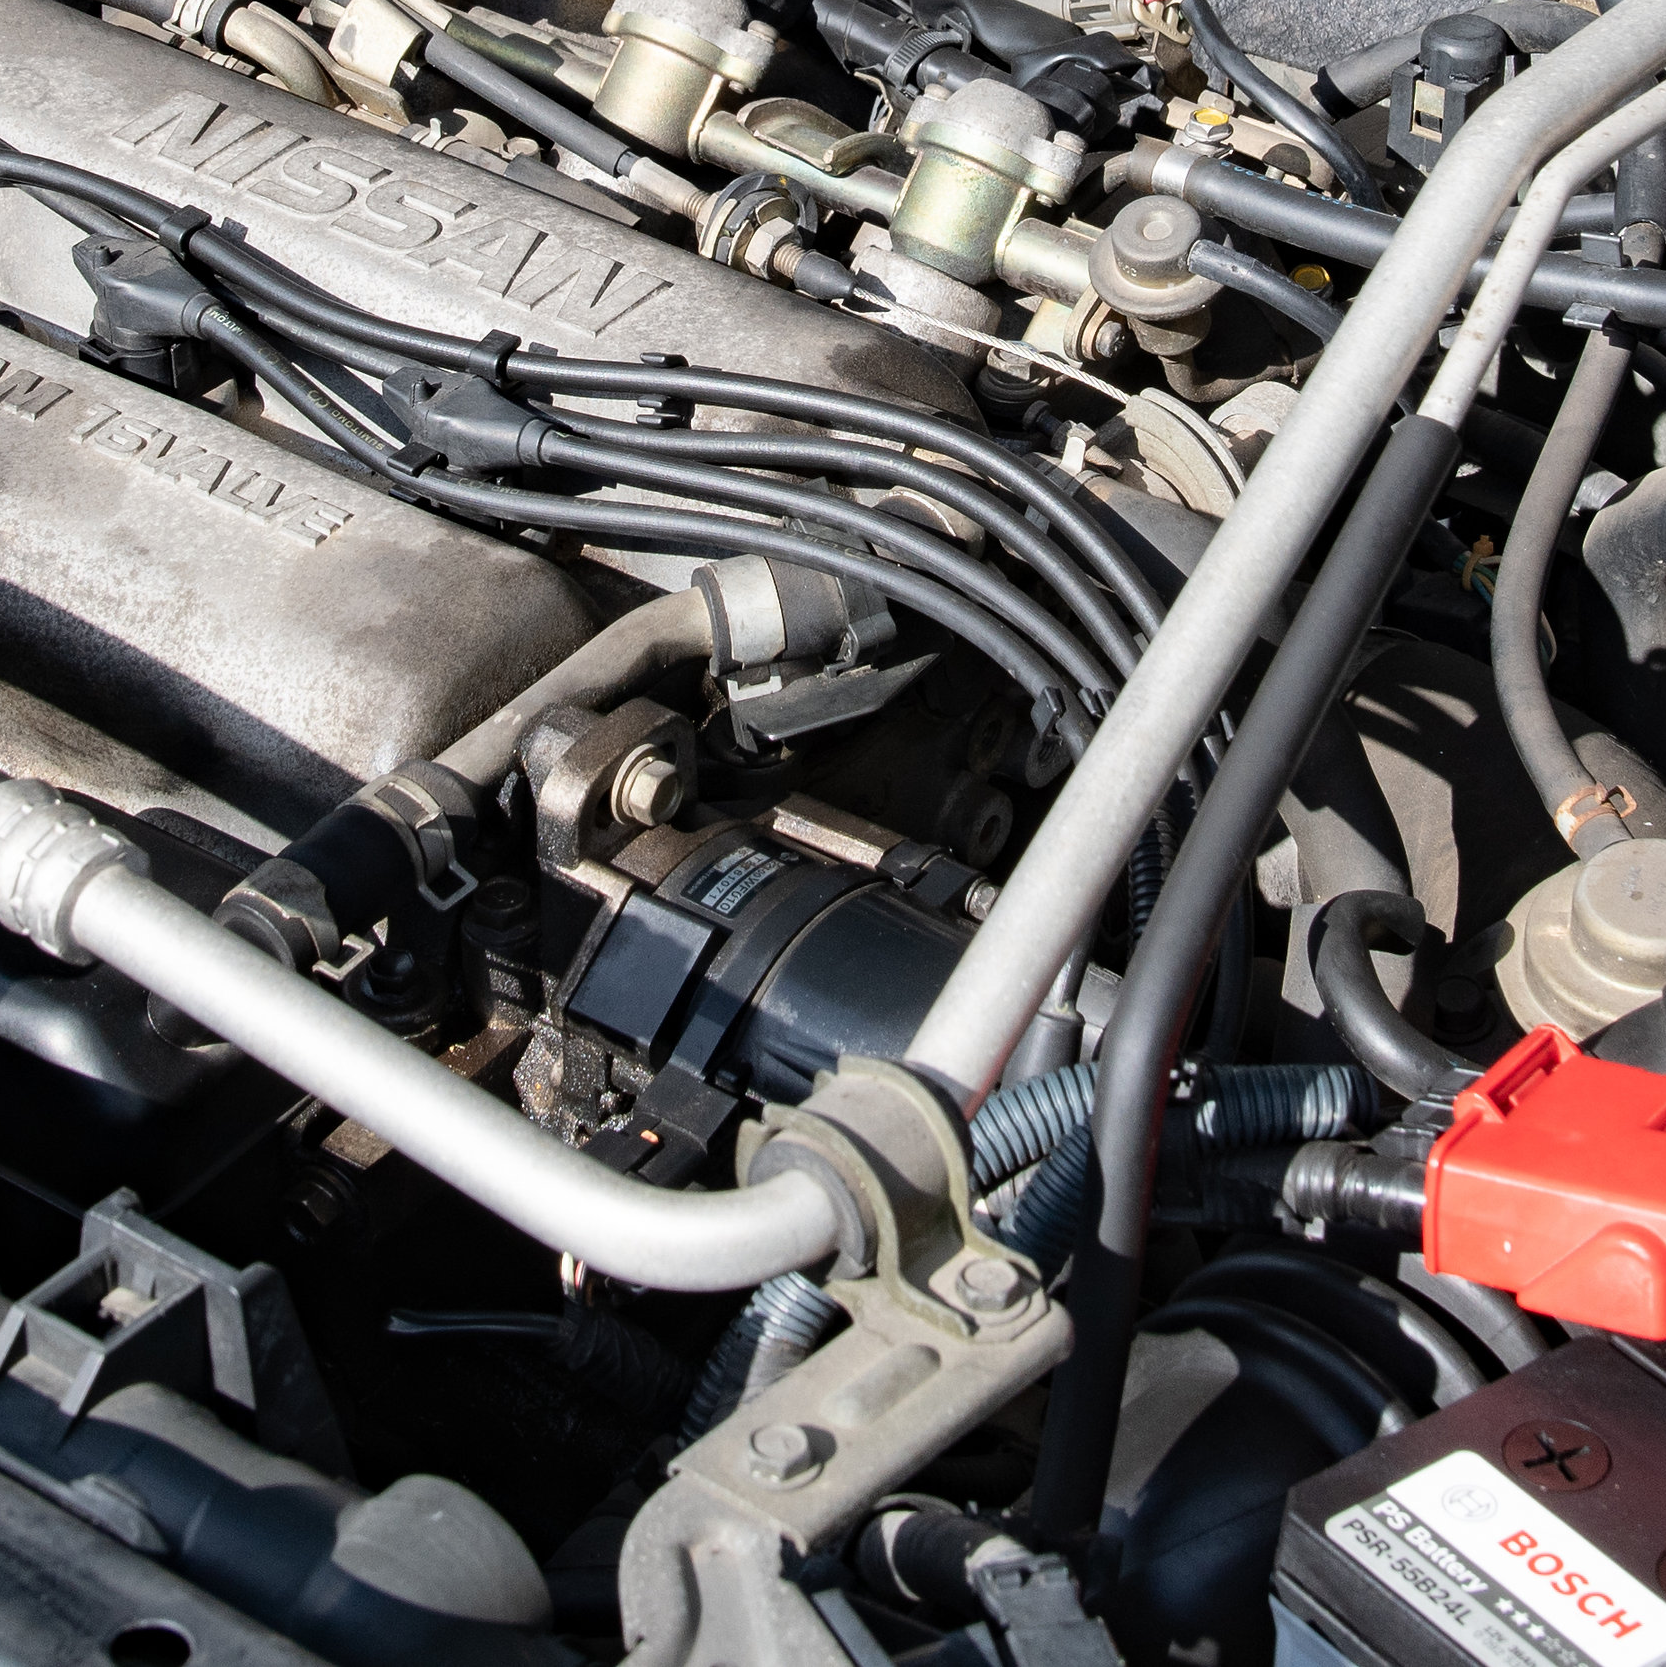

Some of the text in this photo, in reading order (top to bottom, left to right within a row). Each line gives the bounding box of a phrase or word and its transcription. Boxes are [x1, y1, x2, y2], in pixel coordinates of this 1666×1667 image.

[110, 89, 676, 340] NISSAN
[330, 409, 386, 451] SUMITOMO
[1341, 1516, 1475, 1628] PSR-55B24L
[1372, 1498, 1489, 1596] PS Battery
[1497, 1528, 1644, 1641] BOSCH
